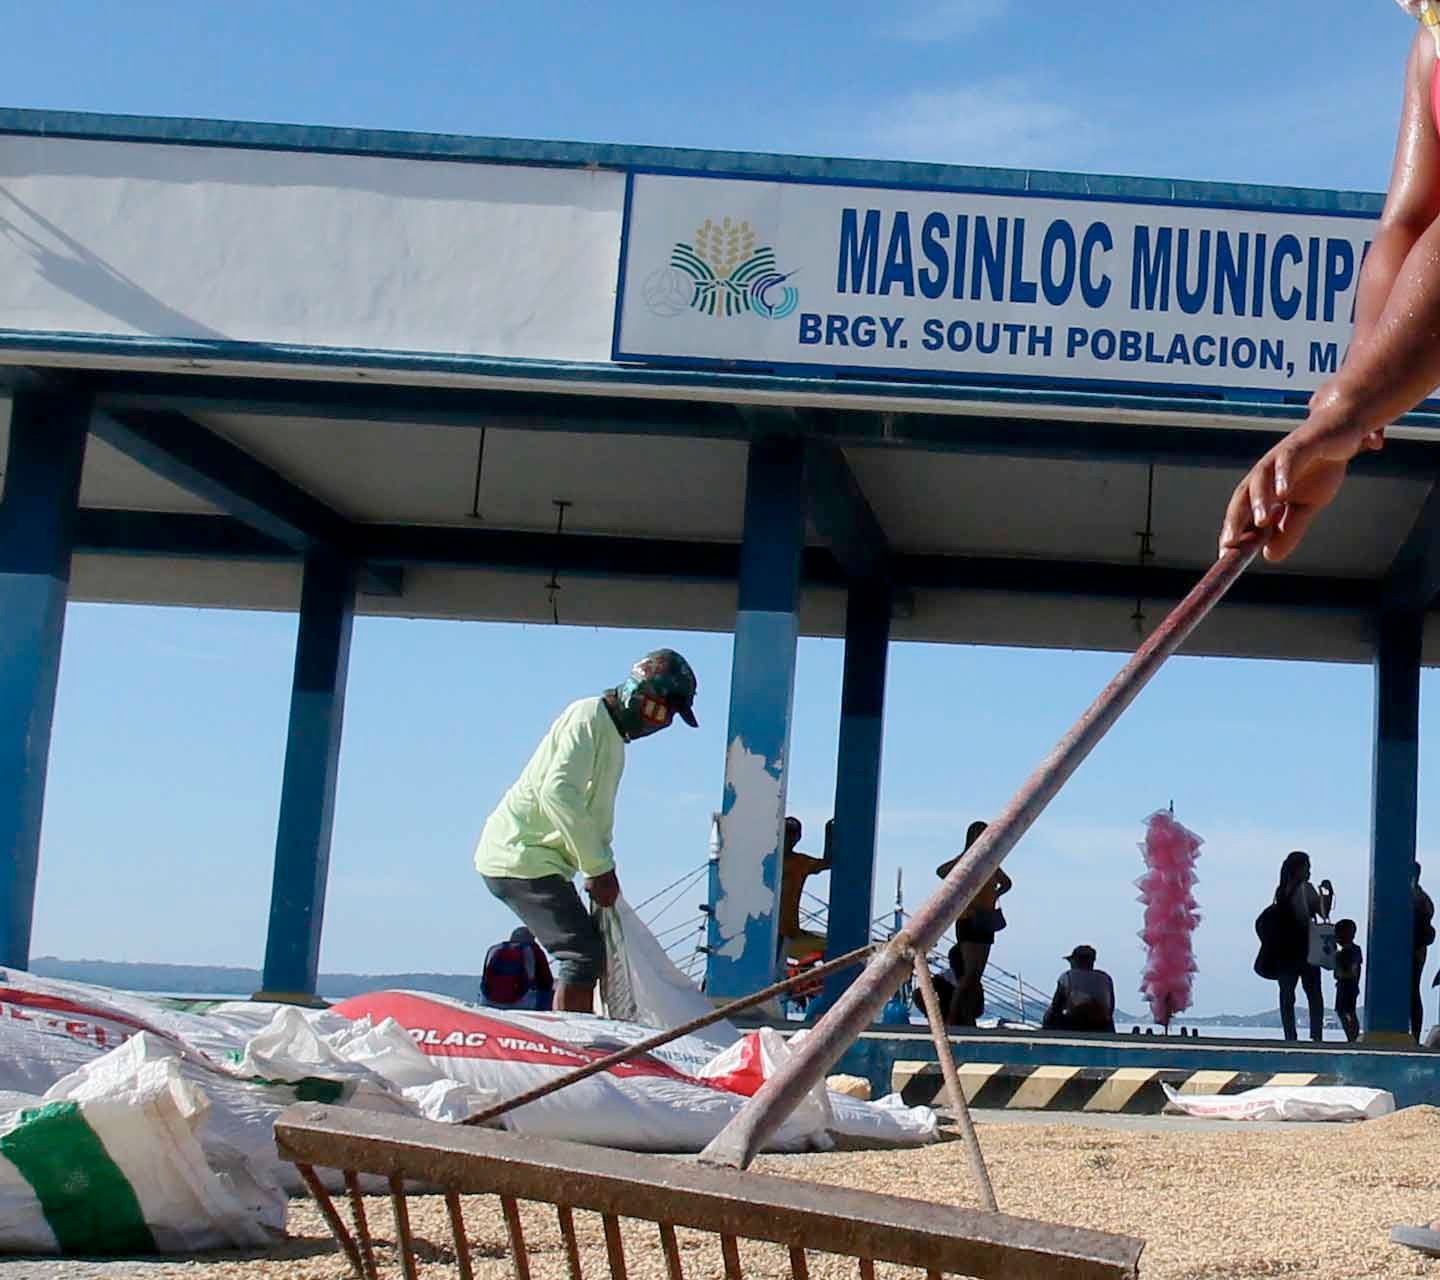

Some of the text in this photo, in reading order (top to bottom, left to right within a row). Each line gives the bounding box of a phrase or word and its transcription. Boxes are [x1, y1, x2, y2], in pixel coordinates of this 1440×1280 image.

[836, 207, 1374, 325] MASINLOC MUNICIP
[798, 312, 908, 349] BRGY.
[921, 319, 1053, 357] SOUTH
[1066, 326, 1296, 379] POBLACION,
[407, 1027, 549, 1054] OLAC VITAL
